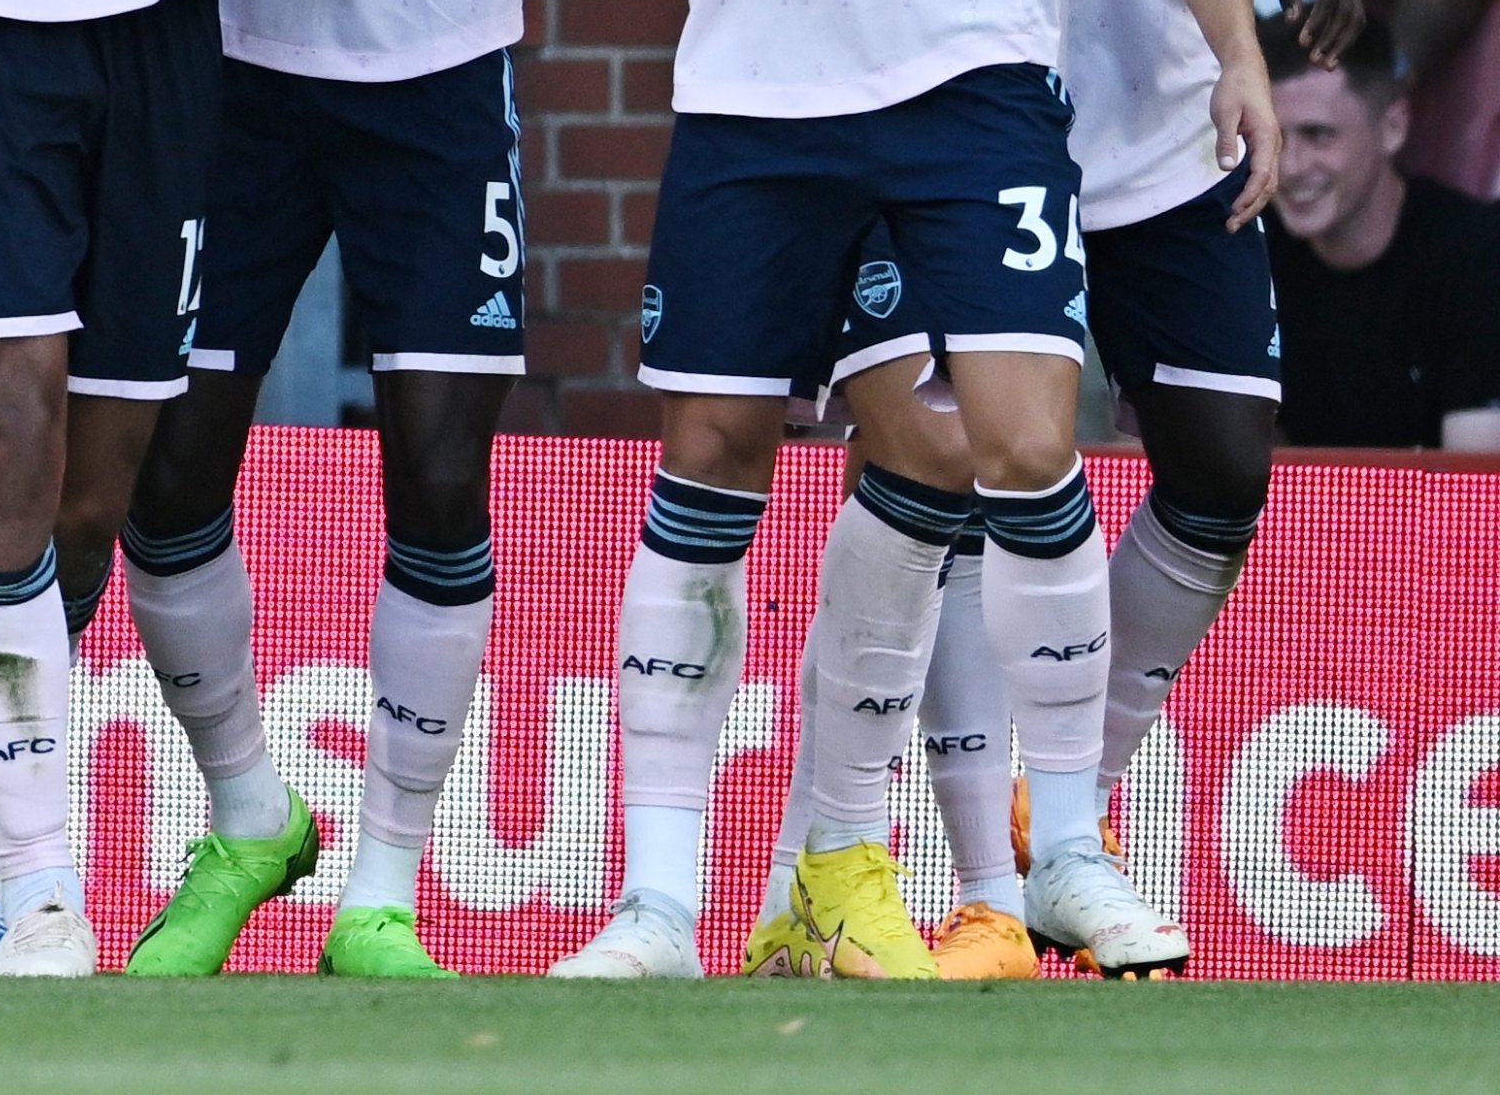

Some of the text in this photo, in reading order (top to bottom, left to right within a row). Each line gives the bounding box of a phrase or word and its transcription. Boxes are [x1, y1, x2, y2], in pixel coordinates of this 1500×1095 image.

[480, 181, 519, 279] 5
[177, 216, 206, 316] 1
[470, 314, 516, 329] adidas
[1031, 631, 1107, 661] AFC
[622, 655, 705, 679] AFC
[377, 696, 447, 734] AFC
[853, 693, 914, 714] AFC
[925, 734, 986, 755] AFC
